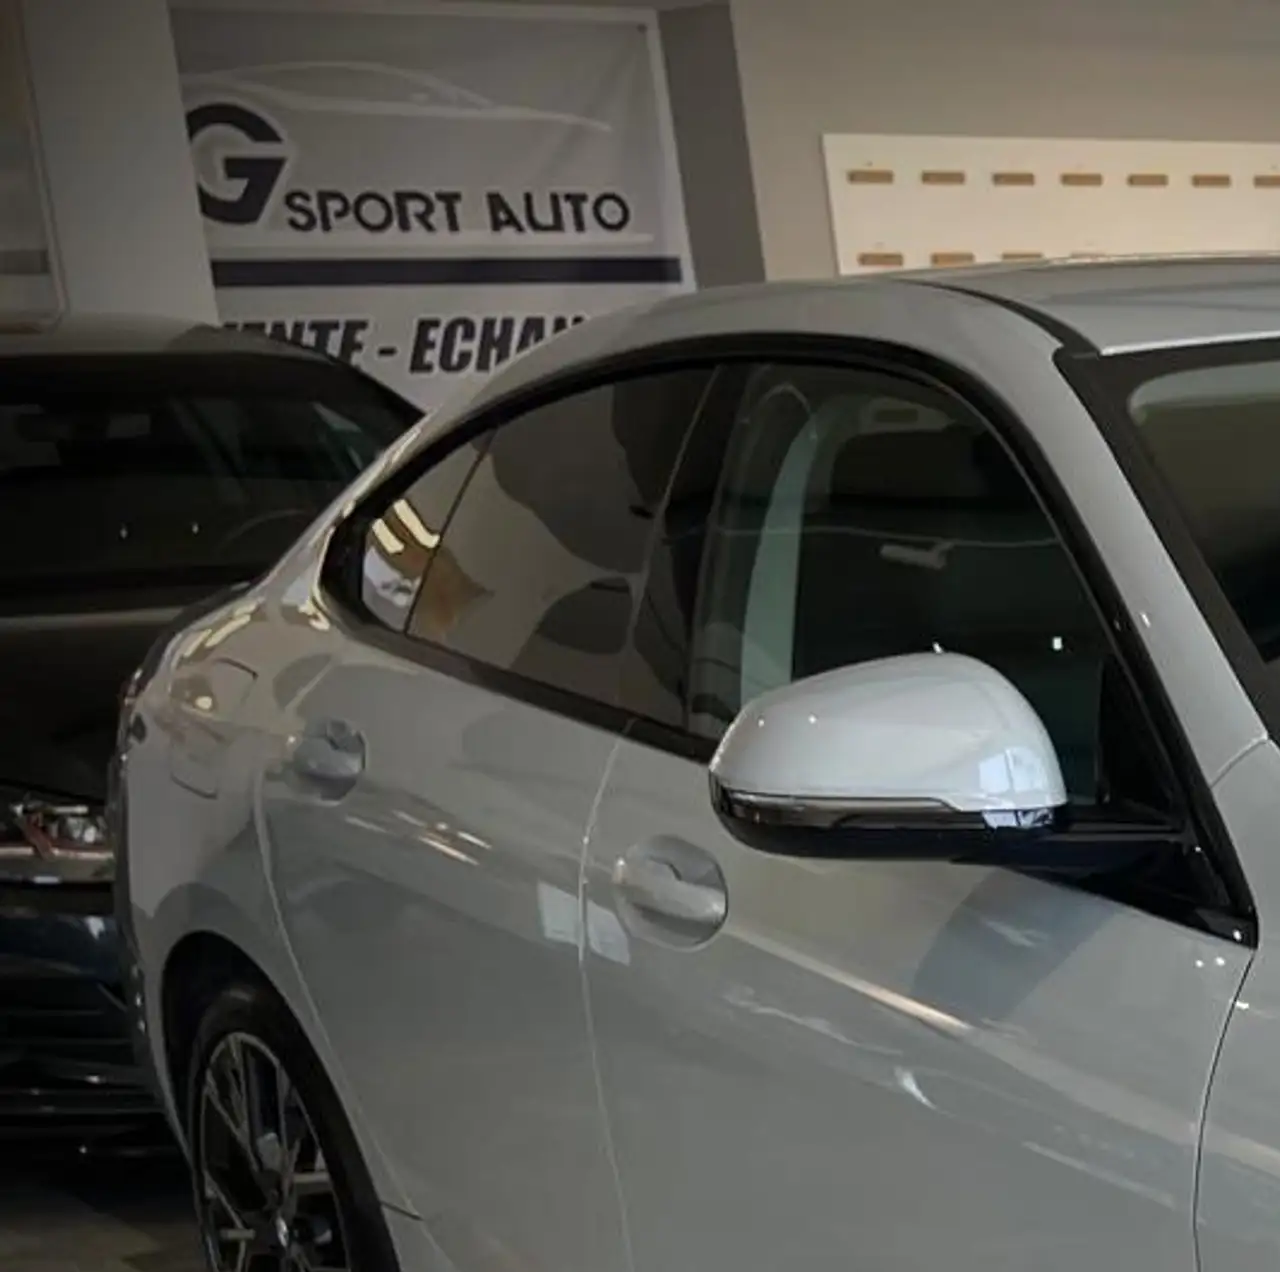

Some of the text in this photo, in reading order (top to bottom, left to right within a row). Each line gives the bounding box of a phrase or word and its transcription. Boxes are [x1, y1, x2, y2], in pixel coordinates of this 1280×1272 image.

[284, 190, 463, 233] SPORT
[486, 191, 631, 233] AUTO
[409, 316, 586, 374] ECHA
